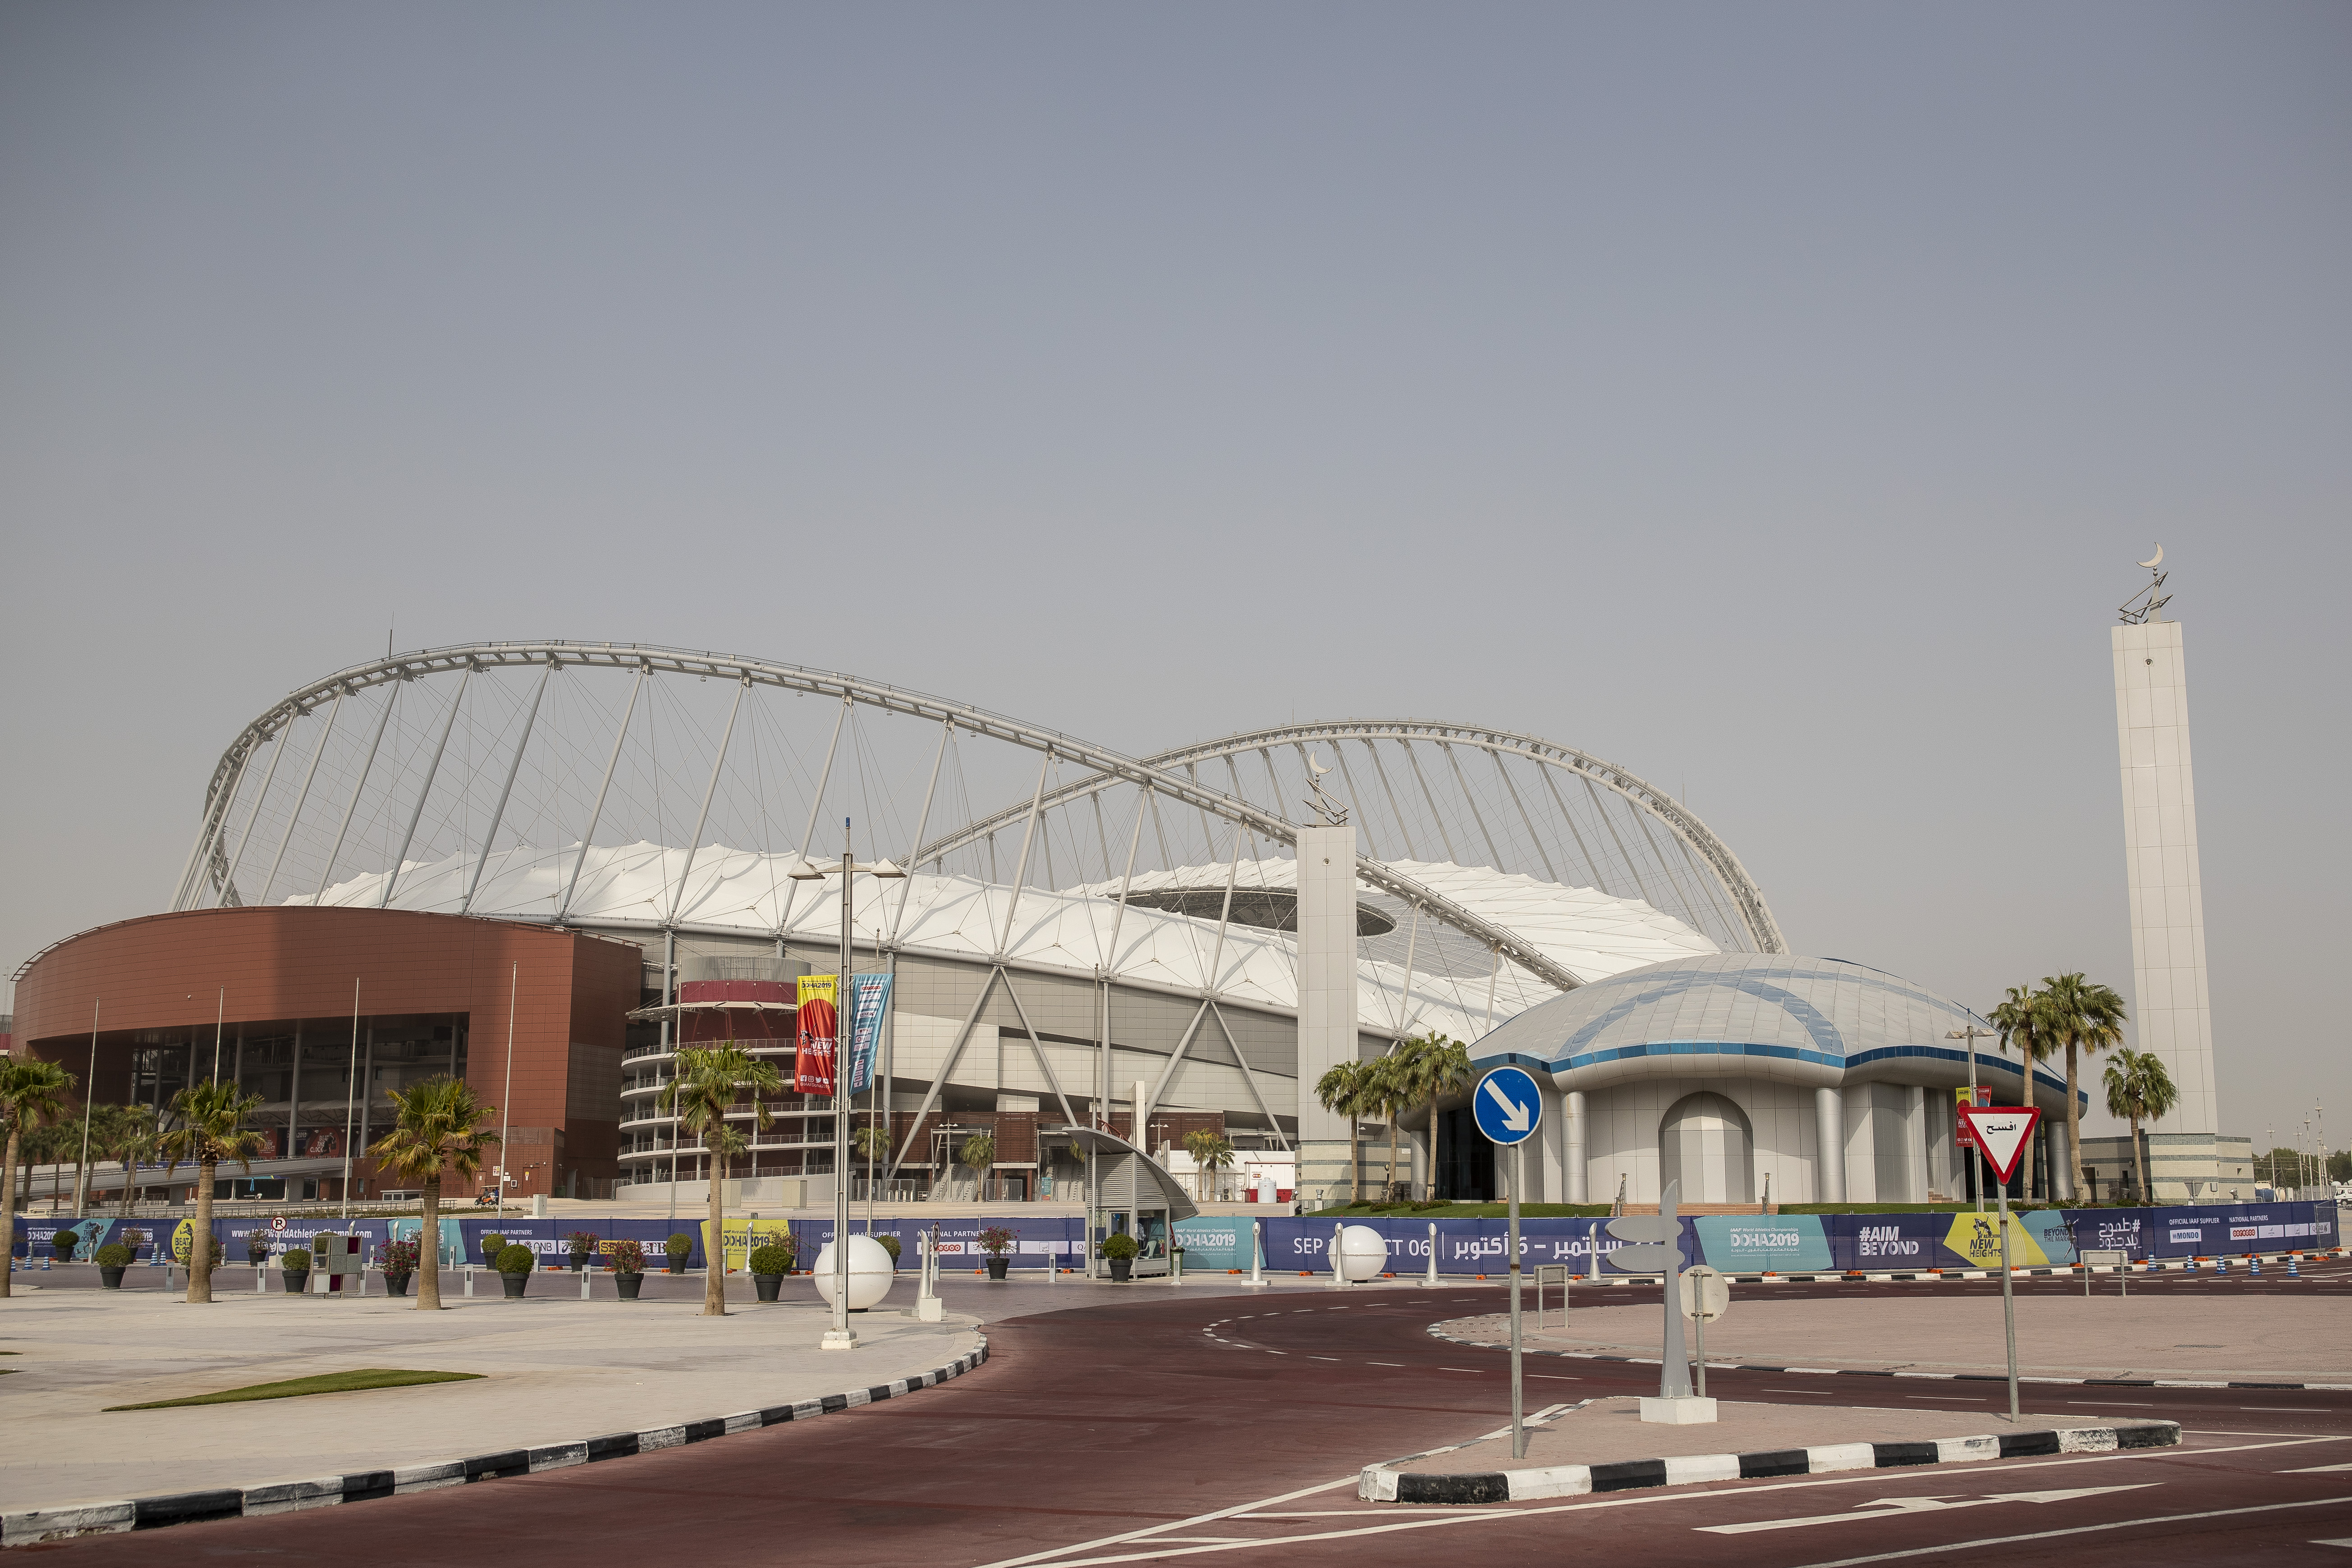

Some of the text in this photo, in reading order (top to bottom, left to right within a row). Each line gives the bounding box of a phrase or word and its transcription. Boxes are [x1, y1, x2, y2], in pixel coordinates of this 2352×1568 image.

[811, 1041, 833, 1050] NEW
[802, 1048, 831, 1057] HEIGHTS
[1986, 1121, 2016, 1134] افسح
[1859, 1226, 1899, 1242] #AIM
[2044, 1228, 2069, 1236] BEYOND
[1175, 1233, 1236, 1246] DOHA2019
[1293, 1238, 1323, 1254] SEP
[1453, 1231, 1509, 1260] أكتوبر
[1730, 1233, 1799, 1247] DOHA2019
[1970, 1238, 1994, 1249] NEW
[1408, 1239, 1430, 1256] 06
[1859, 1241, 1919, 1256] BEYOND
[1969, 1248, 2002, 1257] HEIGHTS
